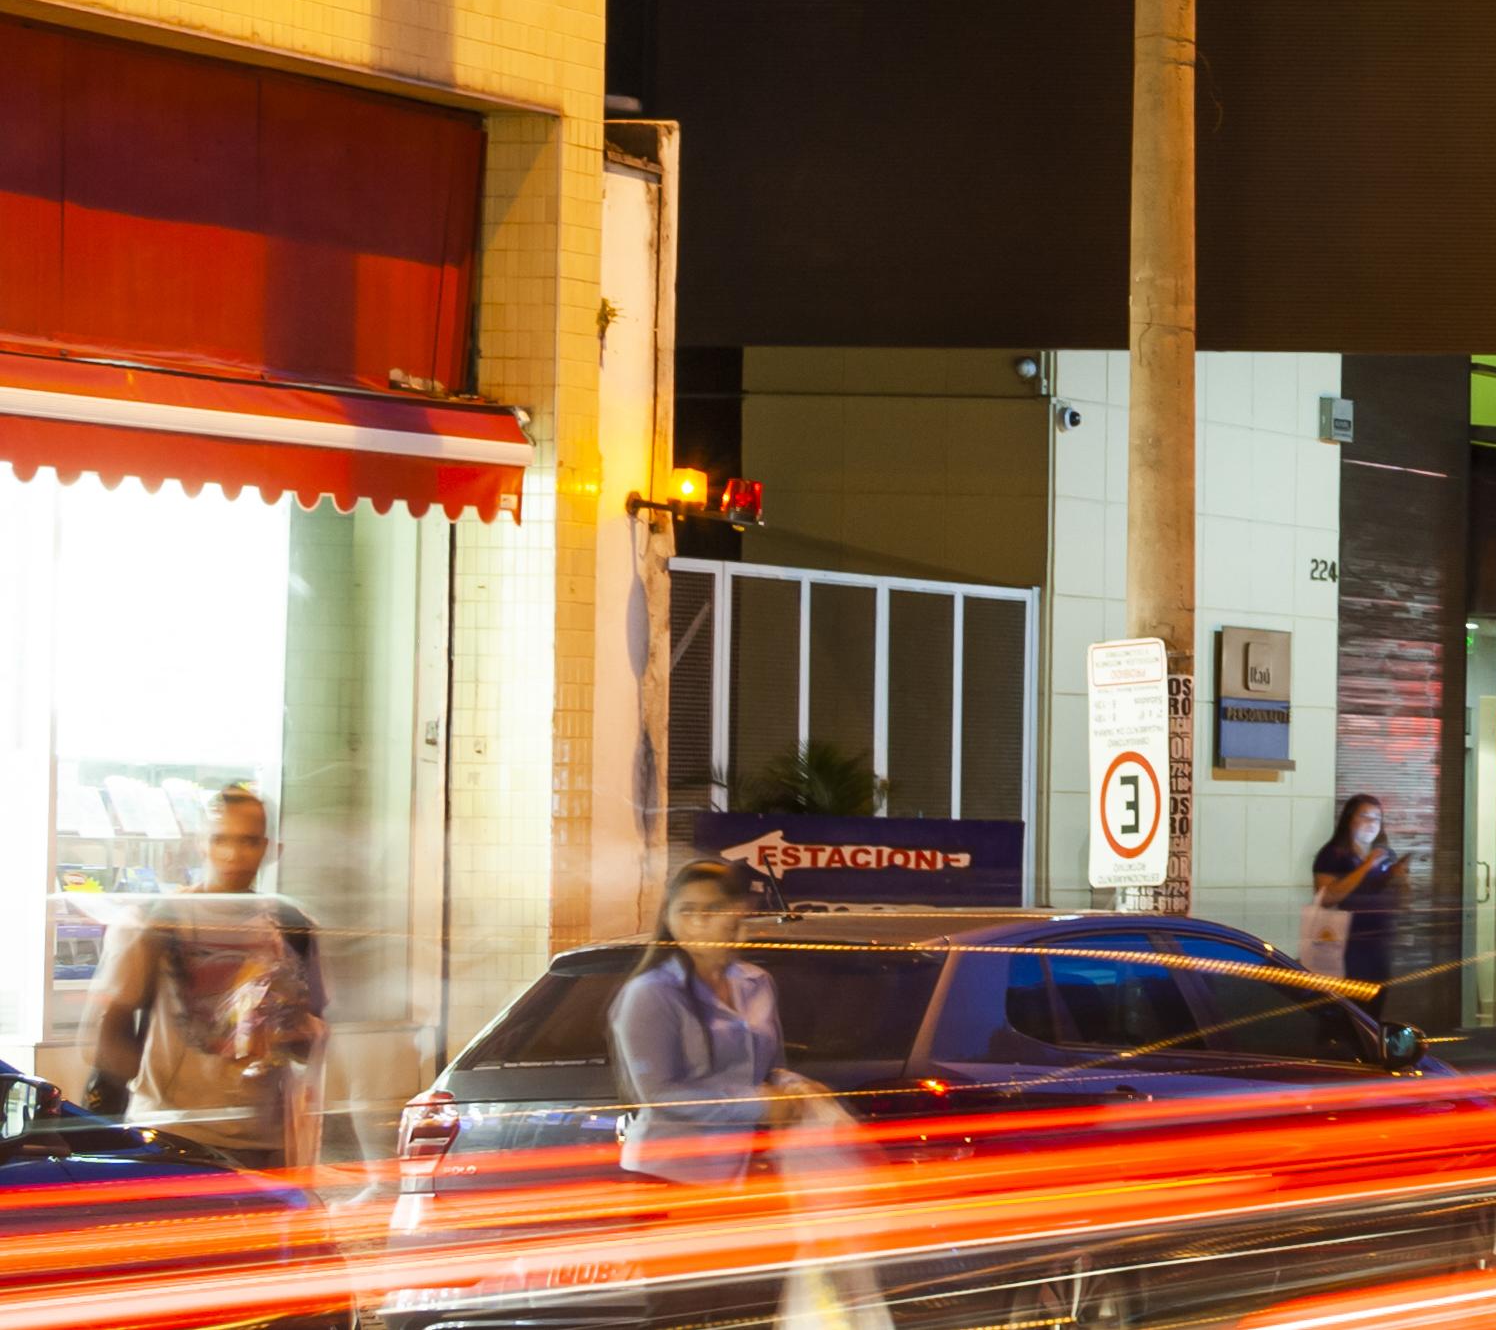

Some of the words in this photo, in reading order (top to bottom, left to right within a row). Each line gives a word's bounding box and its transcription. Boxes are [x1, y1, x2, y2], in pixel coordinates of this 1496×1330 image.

[1250, 667, 1271, 684] Itaú
[1168, 678, 1192, 696] OS
[1169, 697, 1192, 716] RO
